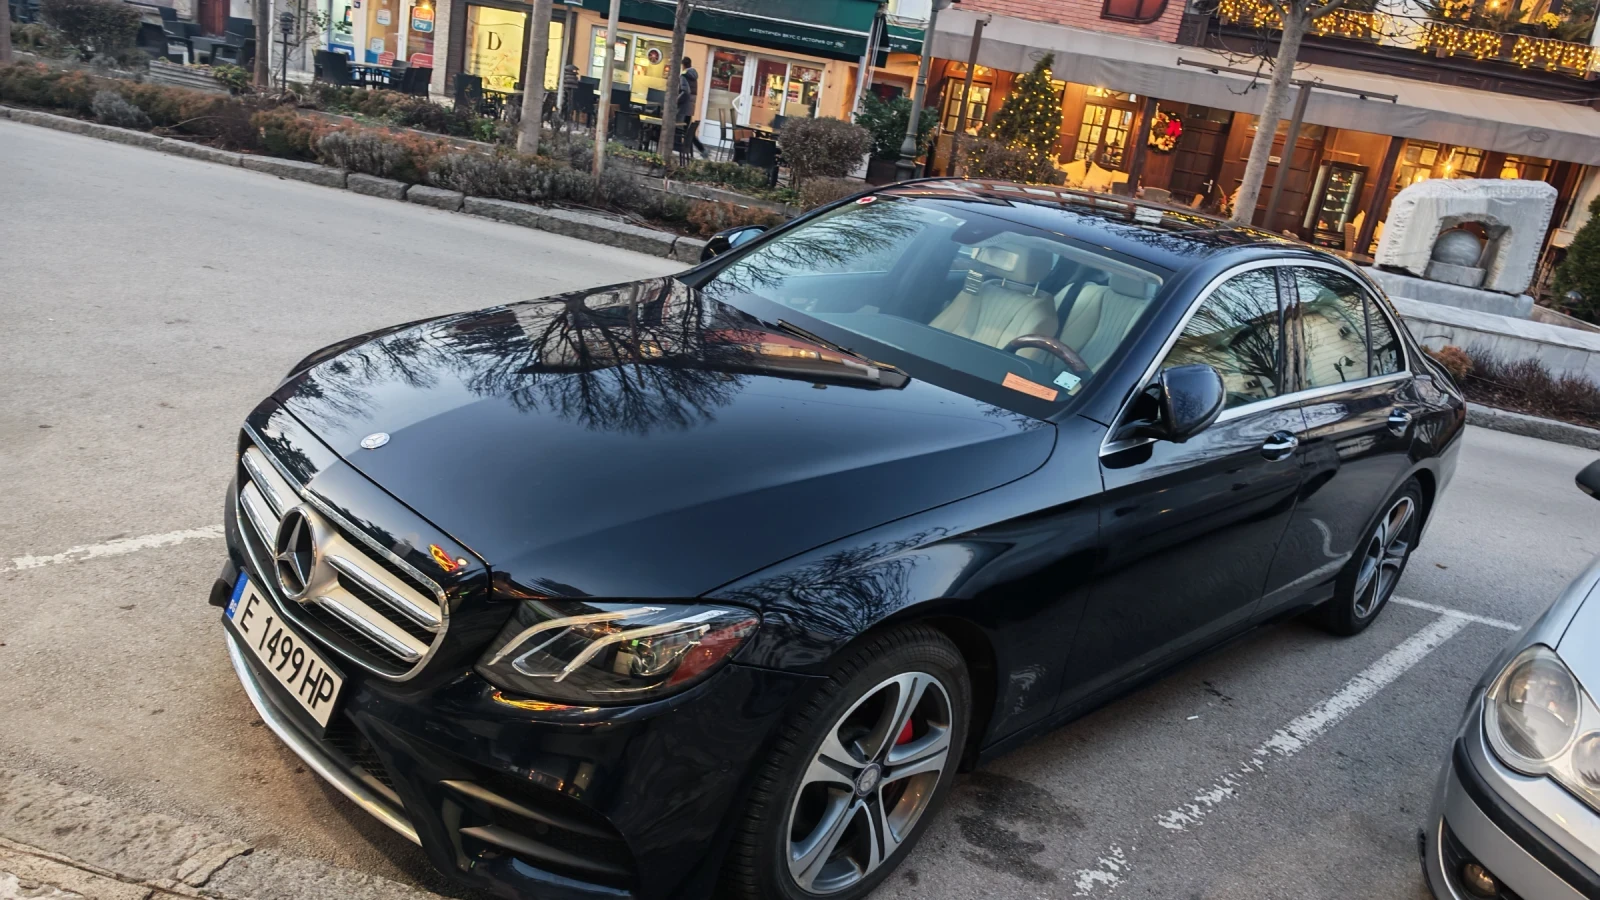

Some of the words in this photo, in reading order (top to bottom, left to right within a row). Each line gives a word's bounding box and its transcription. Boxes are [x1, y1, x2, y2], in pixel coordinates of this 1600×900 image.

[415, 10, 432, 19] Easy
[414, 20, 428, 29] Pay
[749, 27, 781, 36] АВТЕНТИЧЕН
[801, 36, 825, 45] ИСТОРИЯ
[228, 599, 236, 613] BG
[240, 592, 260, 634] E
